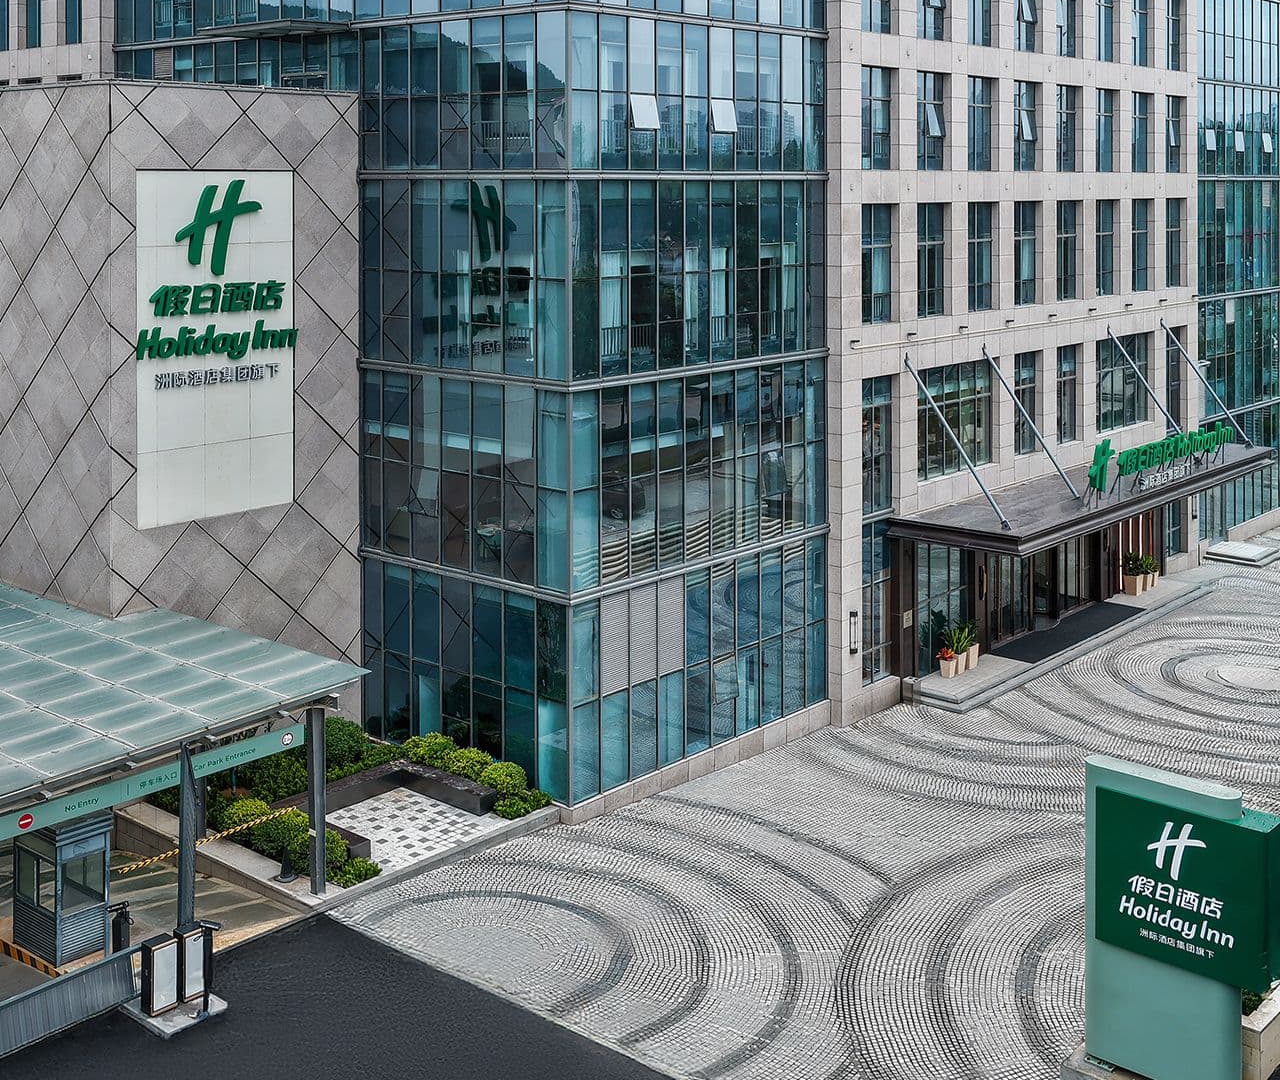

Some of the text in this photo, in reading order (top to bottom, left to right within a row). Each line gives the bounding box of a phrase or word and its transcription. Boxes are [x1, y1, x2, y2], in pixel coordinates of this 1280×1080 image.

[149, 280, 286, 317] 假日酒店
[136, 320, 299, 360] Holiday Inn
[154, 363, 280, 390] 洲际酒店集团旗下
[1117, 421, 1235, 476] 假日酒店 Holiday Inn
[193, 748, 257, 772] Car Park Entrance
[139, 771, 177, 790] 停车场入口
[64, 797, 100, 813] No Entry
[1128, 874, 1224, 919] 假日酒店
[1119, 895, 1234, 949] Holiday Inn
[1139, 927, 1216, 959] 洲际酒店集团旗下
